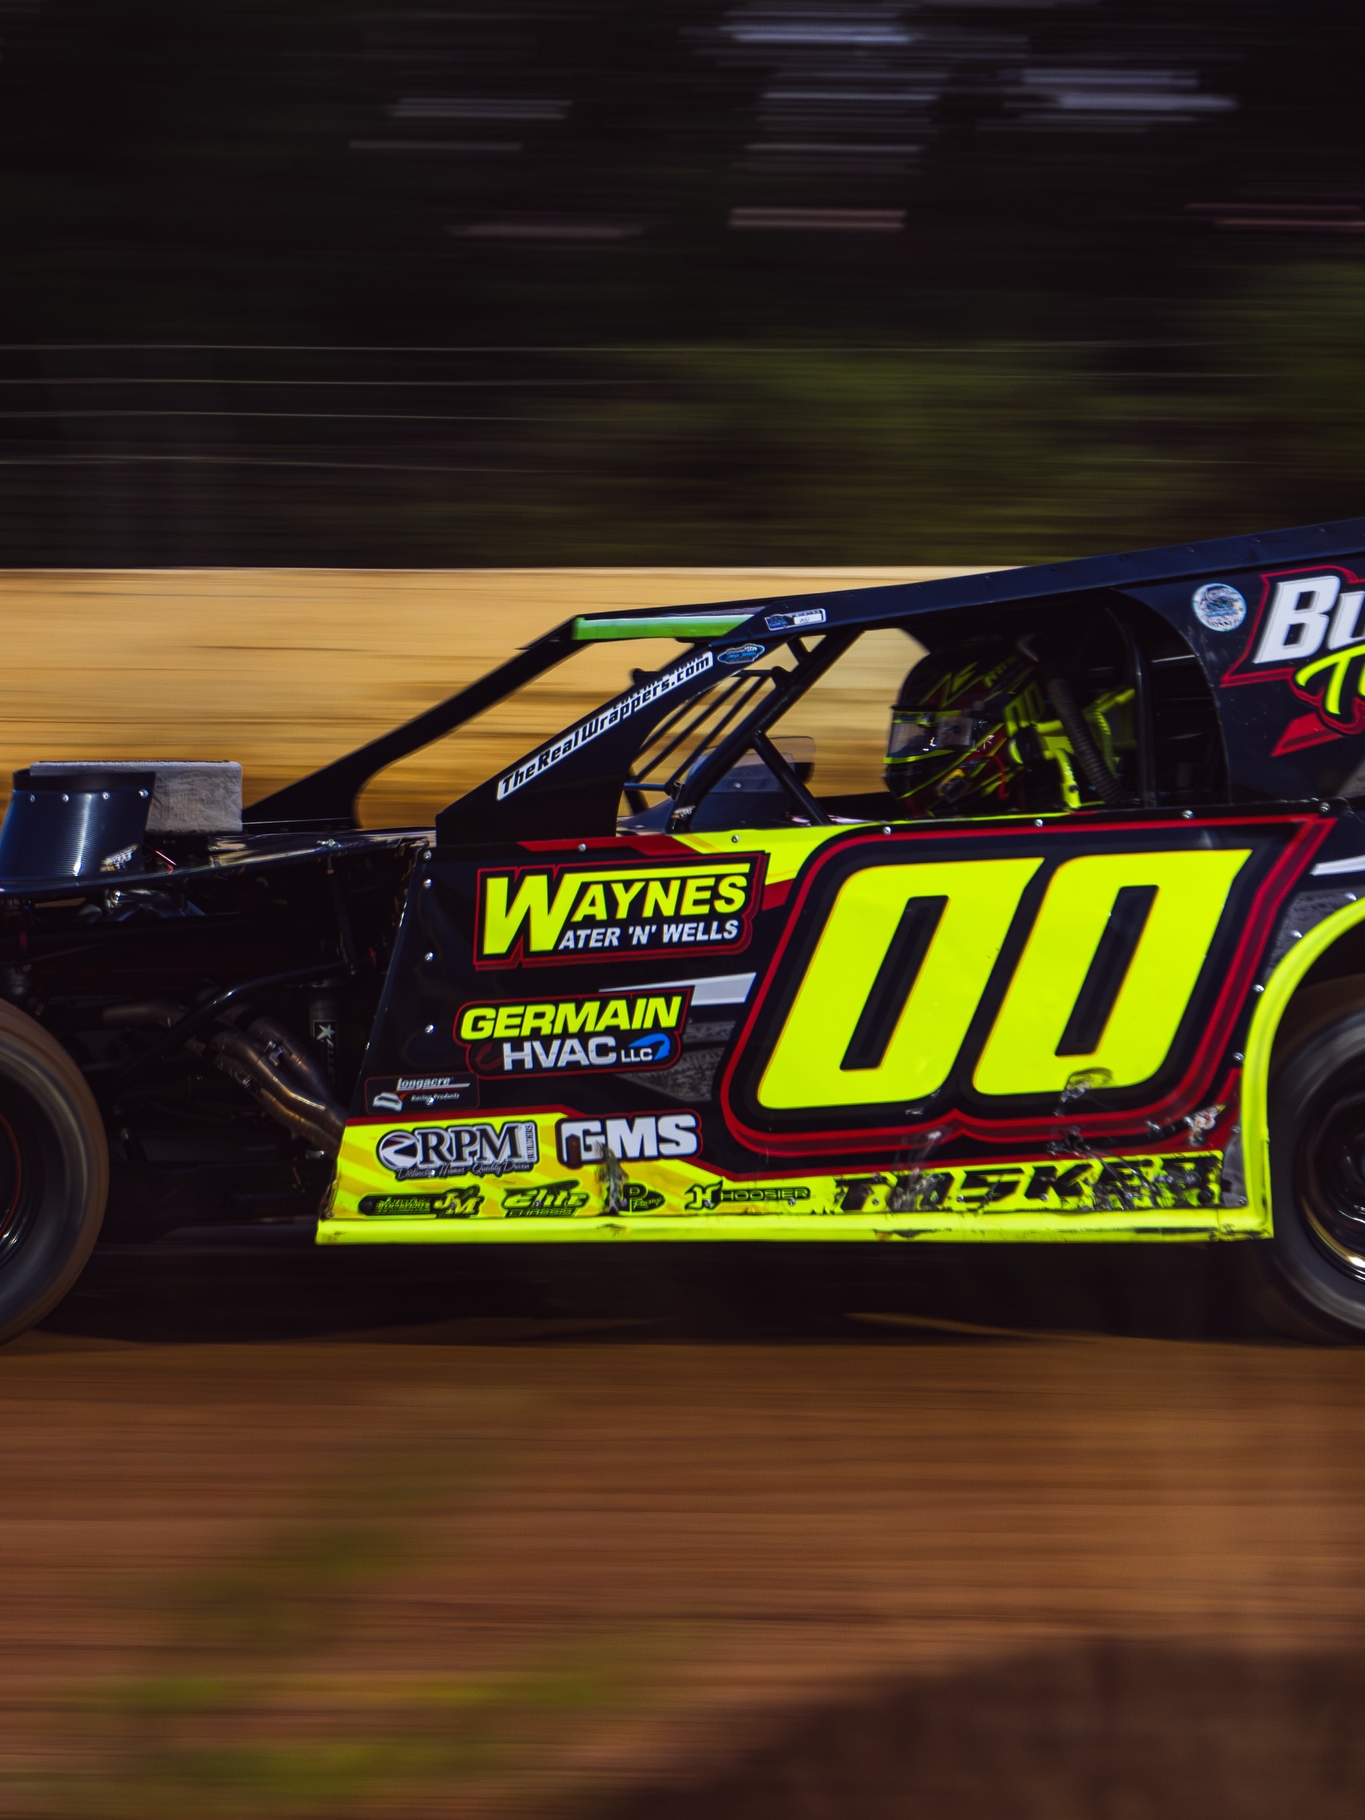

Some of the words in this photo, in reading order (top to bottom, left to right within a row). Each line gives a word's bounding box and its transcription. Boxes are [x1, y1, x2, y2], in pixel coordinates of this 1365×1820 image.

[500, 656, 711, 795] TheRealWrappers.com
[483, 863, 750, 955] WAYNES
[628, 924, 657, 945] 'N'
[662, 919, 739, 943] WELLS
[757, 849, 1252, 1109] 00
[460, 996, 682, 1040] GERMAIN
[502, 1035, 617, 1071] HVAC
[621, 1047, 653, 1063] LLC
[397, 1077, 451, 1091] Longacre
[433, 1092, 460, 1101] Products
[419, 1124, 524, 1165] RPM
[561, 1114, 698, 1163] GMS
[721, 1188, 808, 1201] HOOSIER
